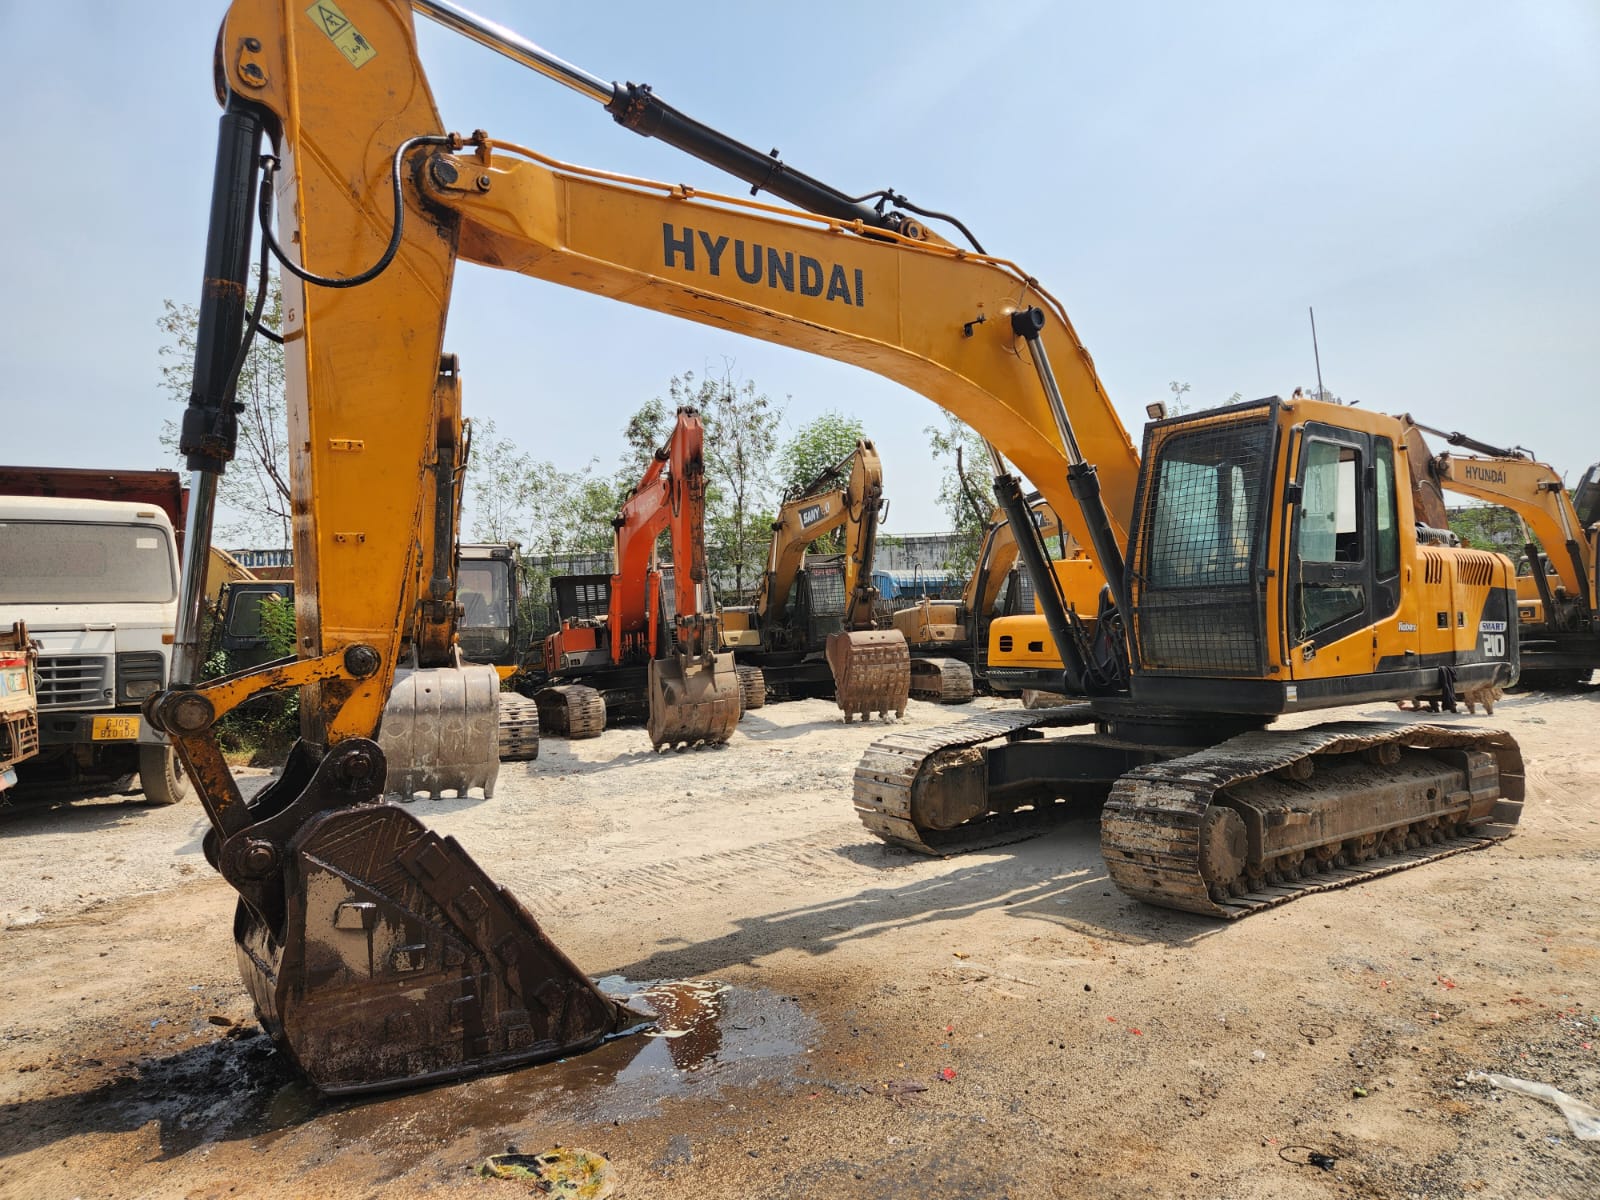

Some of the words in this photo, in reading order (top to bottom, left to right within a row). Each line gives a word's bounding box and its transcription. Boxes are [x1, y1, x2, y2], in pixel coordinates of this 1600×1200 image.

[663, 222, 864, 307] HYUNDAI
[1465, 465, 1506, 484] HYUNDAI
[803, 506, 820, 524] SANY
[1482, 622, 1505, 631] SMART
[1483, 634, 1505, 656] 210
